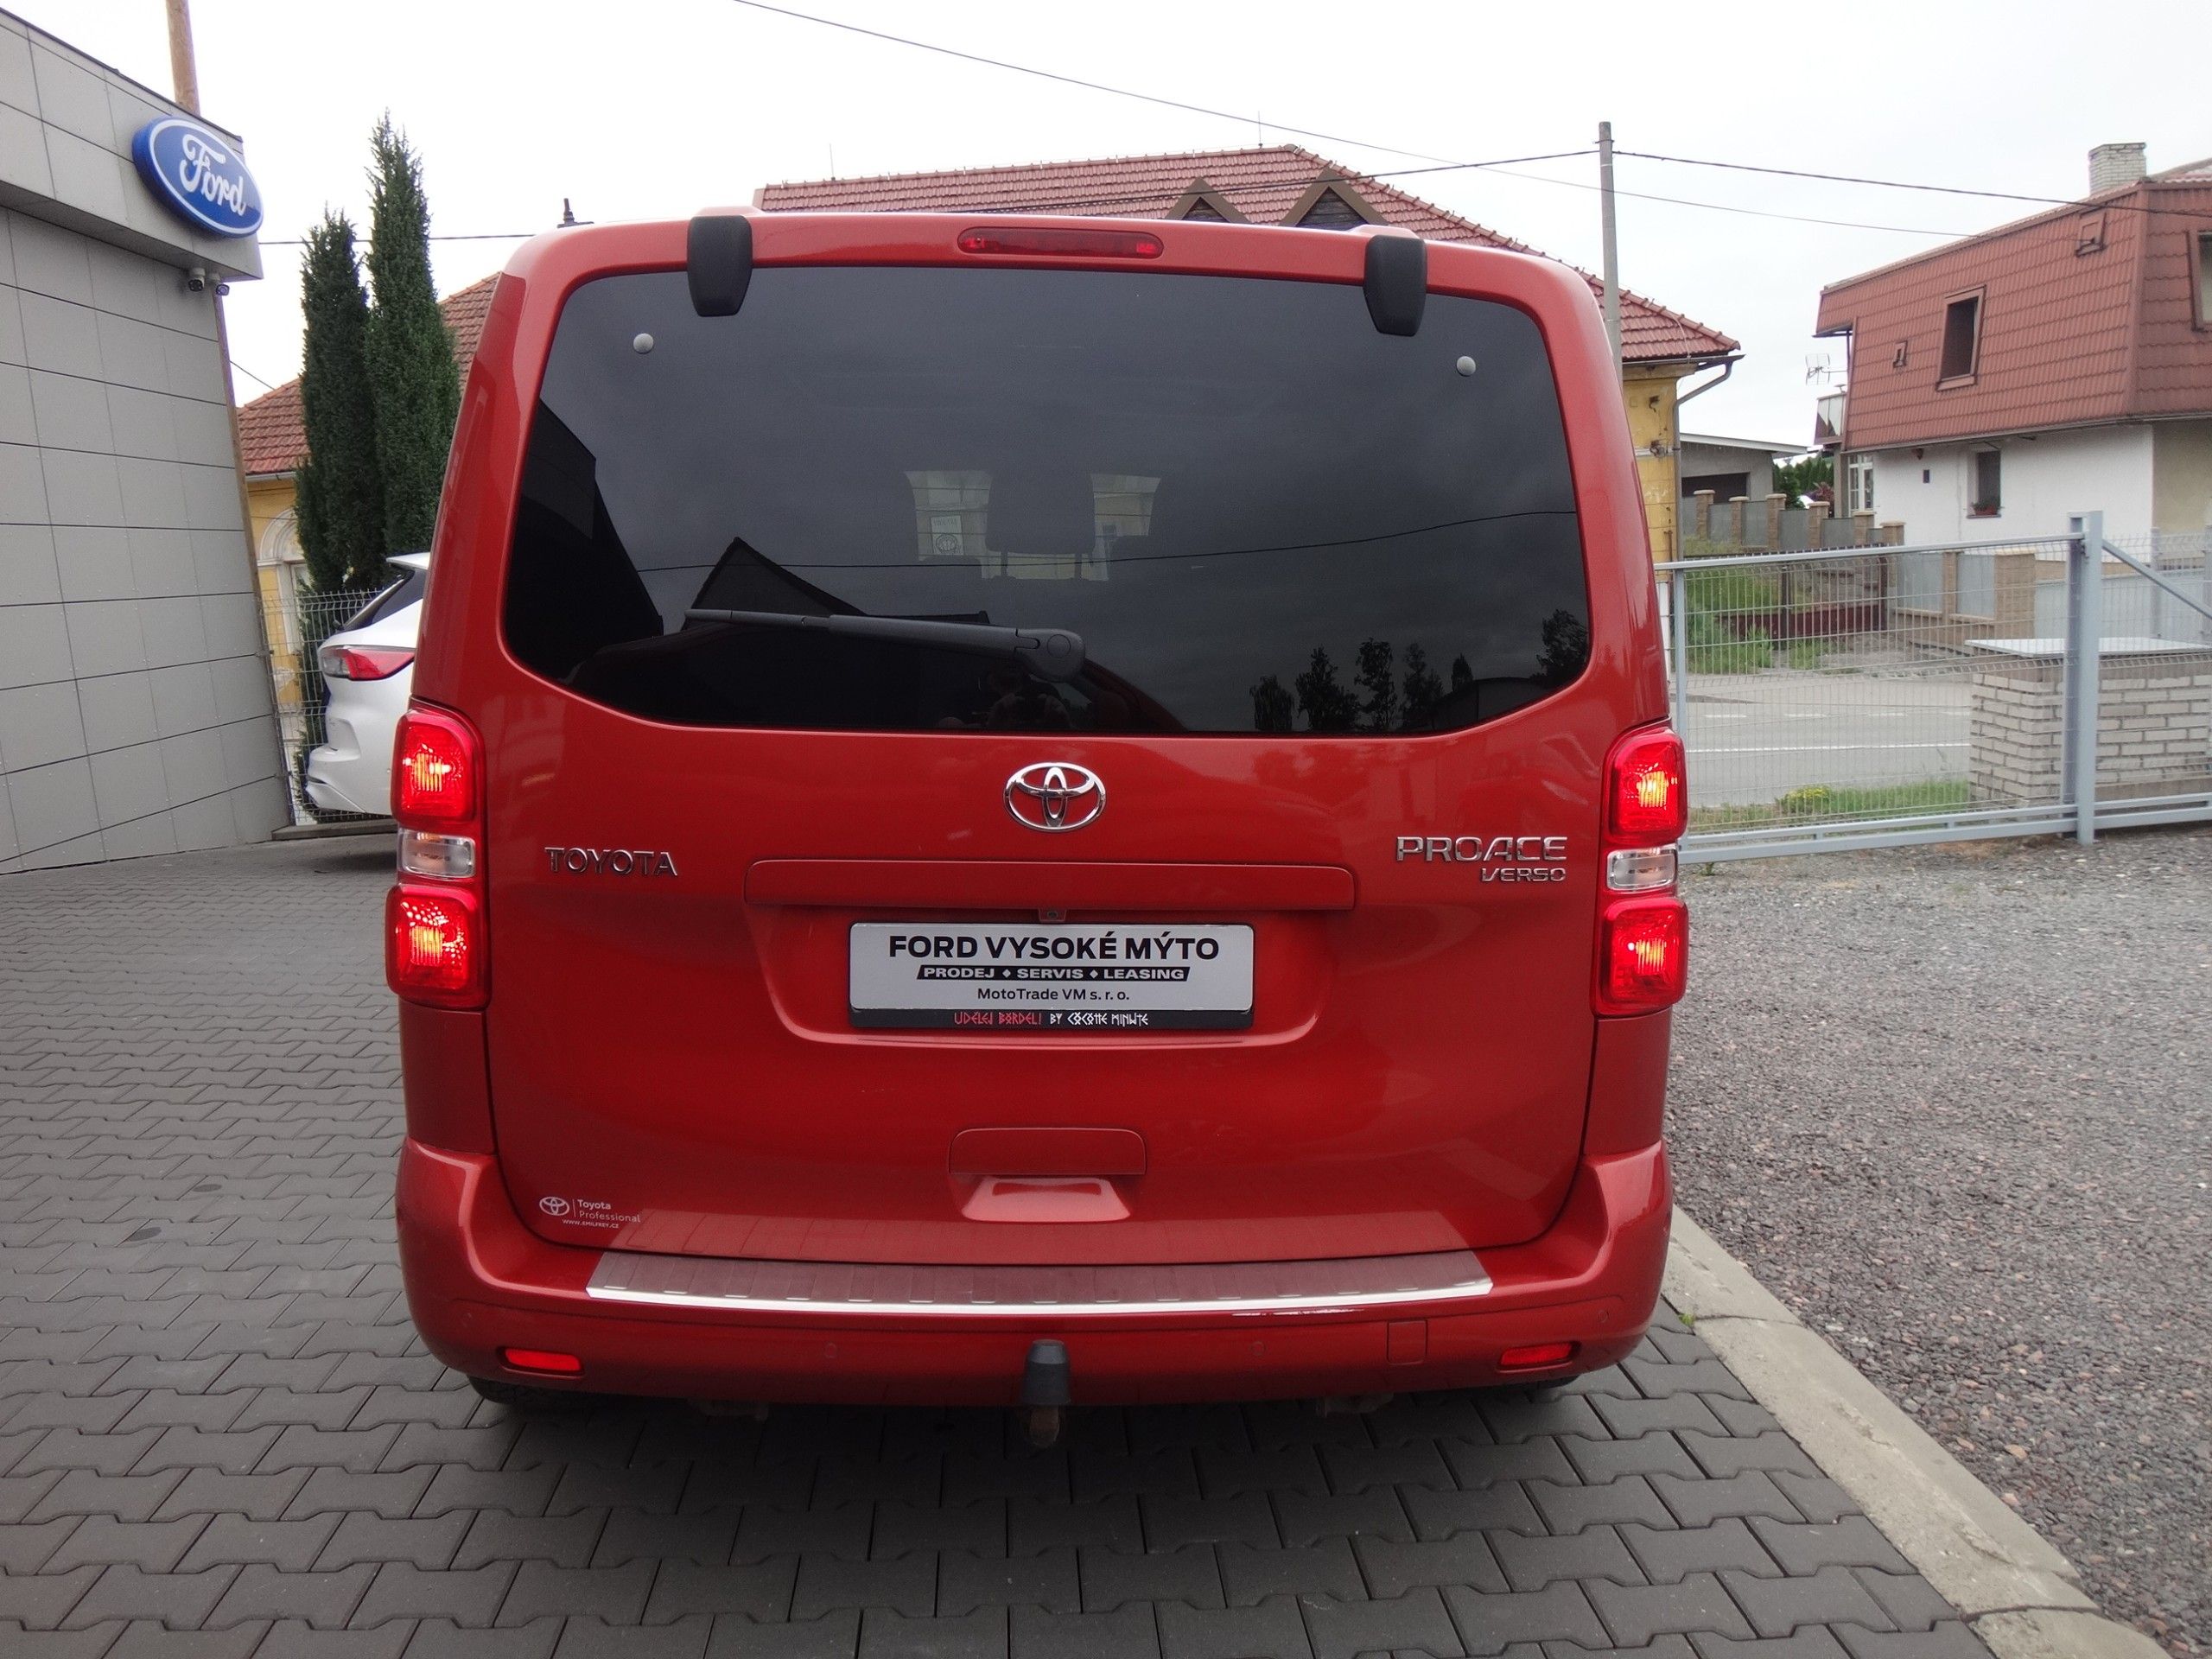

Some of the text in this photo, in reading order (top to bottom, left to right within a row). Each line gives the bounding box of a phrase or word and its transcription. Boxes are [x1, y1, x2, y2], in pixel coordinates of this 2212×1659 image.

[179, 133, 246, 216] Ford
[1395, 836, 1568, 862] PROACE
[544, 846, 678, 876] TOYOTA
[1480, 868, 1567, 882] VERSO
[889, 931, 1219, 960] FORD VYSOKÉ MÝTO
[923, 967, 1185, 980] PRODEJ SERVIS LEASING
[977, 988, 1130, 1001] MotoTrade VM s. r. o.
[1050, 1012, 1062, 1025] BY
[577, 1199, 612, 1210] Toyota
[579, 1211, 641, 1223] Professional
